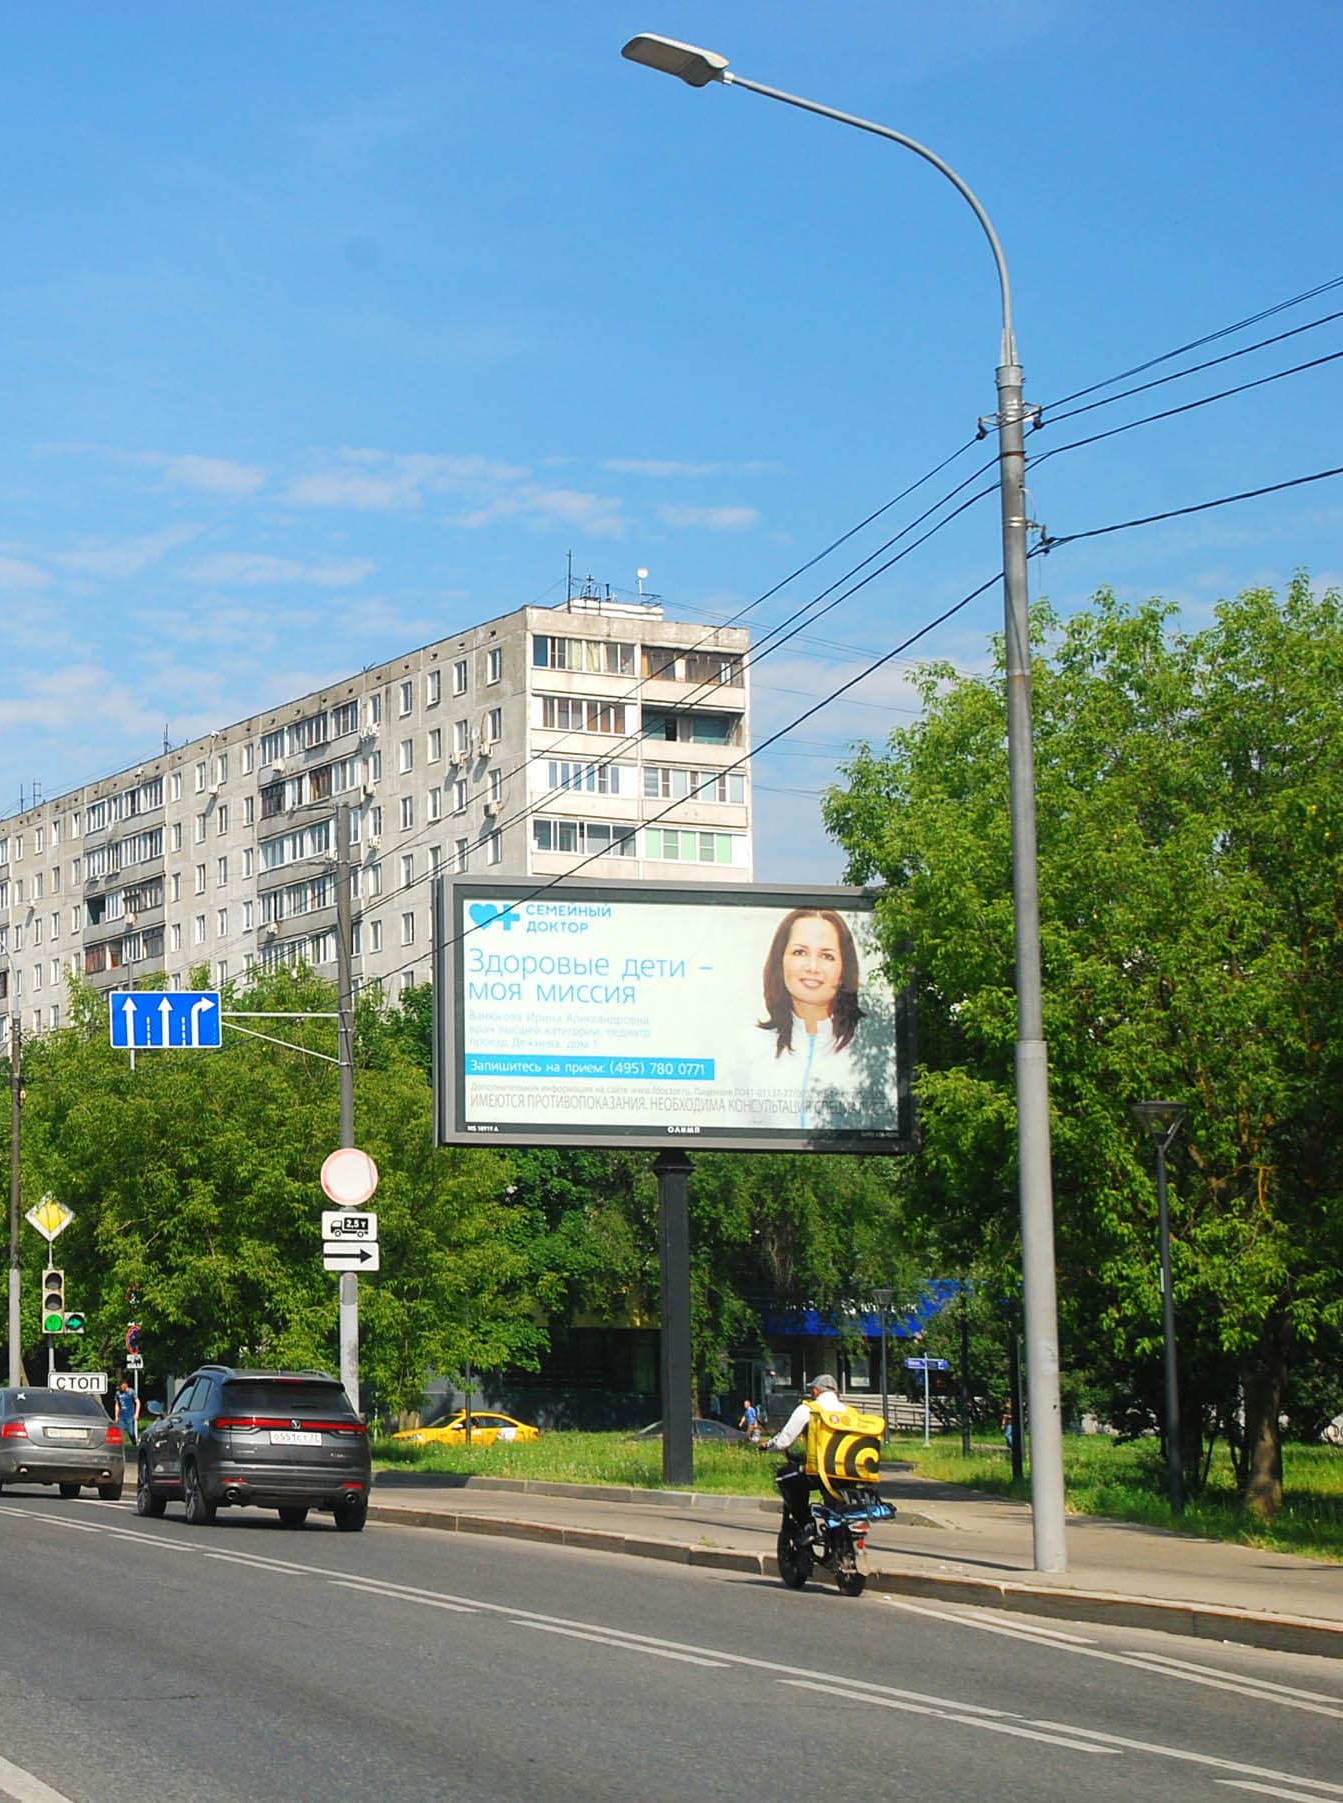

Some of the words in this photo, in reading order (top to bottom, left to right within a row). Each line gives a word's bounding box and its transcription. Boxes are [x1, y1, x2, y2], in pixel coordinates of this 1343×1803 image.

[525, 902, 612, 918] СЕМЕЙНЫЙ
[525, 920, 589, 934] ДОКТОР
[468, 947, 610, 981] Здоровые
[621, 957, 686, 981] дети
[470, 1059, 542, 1073] Запишитесь
[546, 1063, 561, 1073] на
[609, 1060, 646, 1076] (495)
[649, 1062, 675, 1076] 780
[677, 1063, 706, 1076] 0771
[470, 1093, 525, 1108] ИМЕЮТСЯ
[650, 1096, 726, 1114] НЕОБХОДИМА
[346, 1219, 359, 1229] 2,5
[57, 1376, 100, 1390] СТОП
